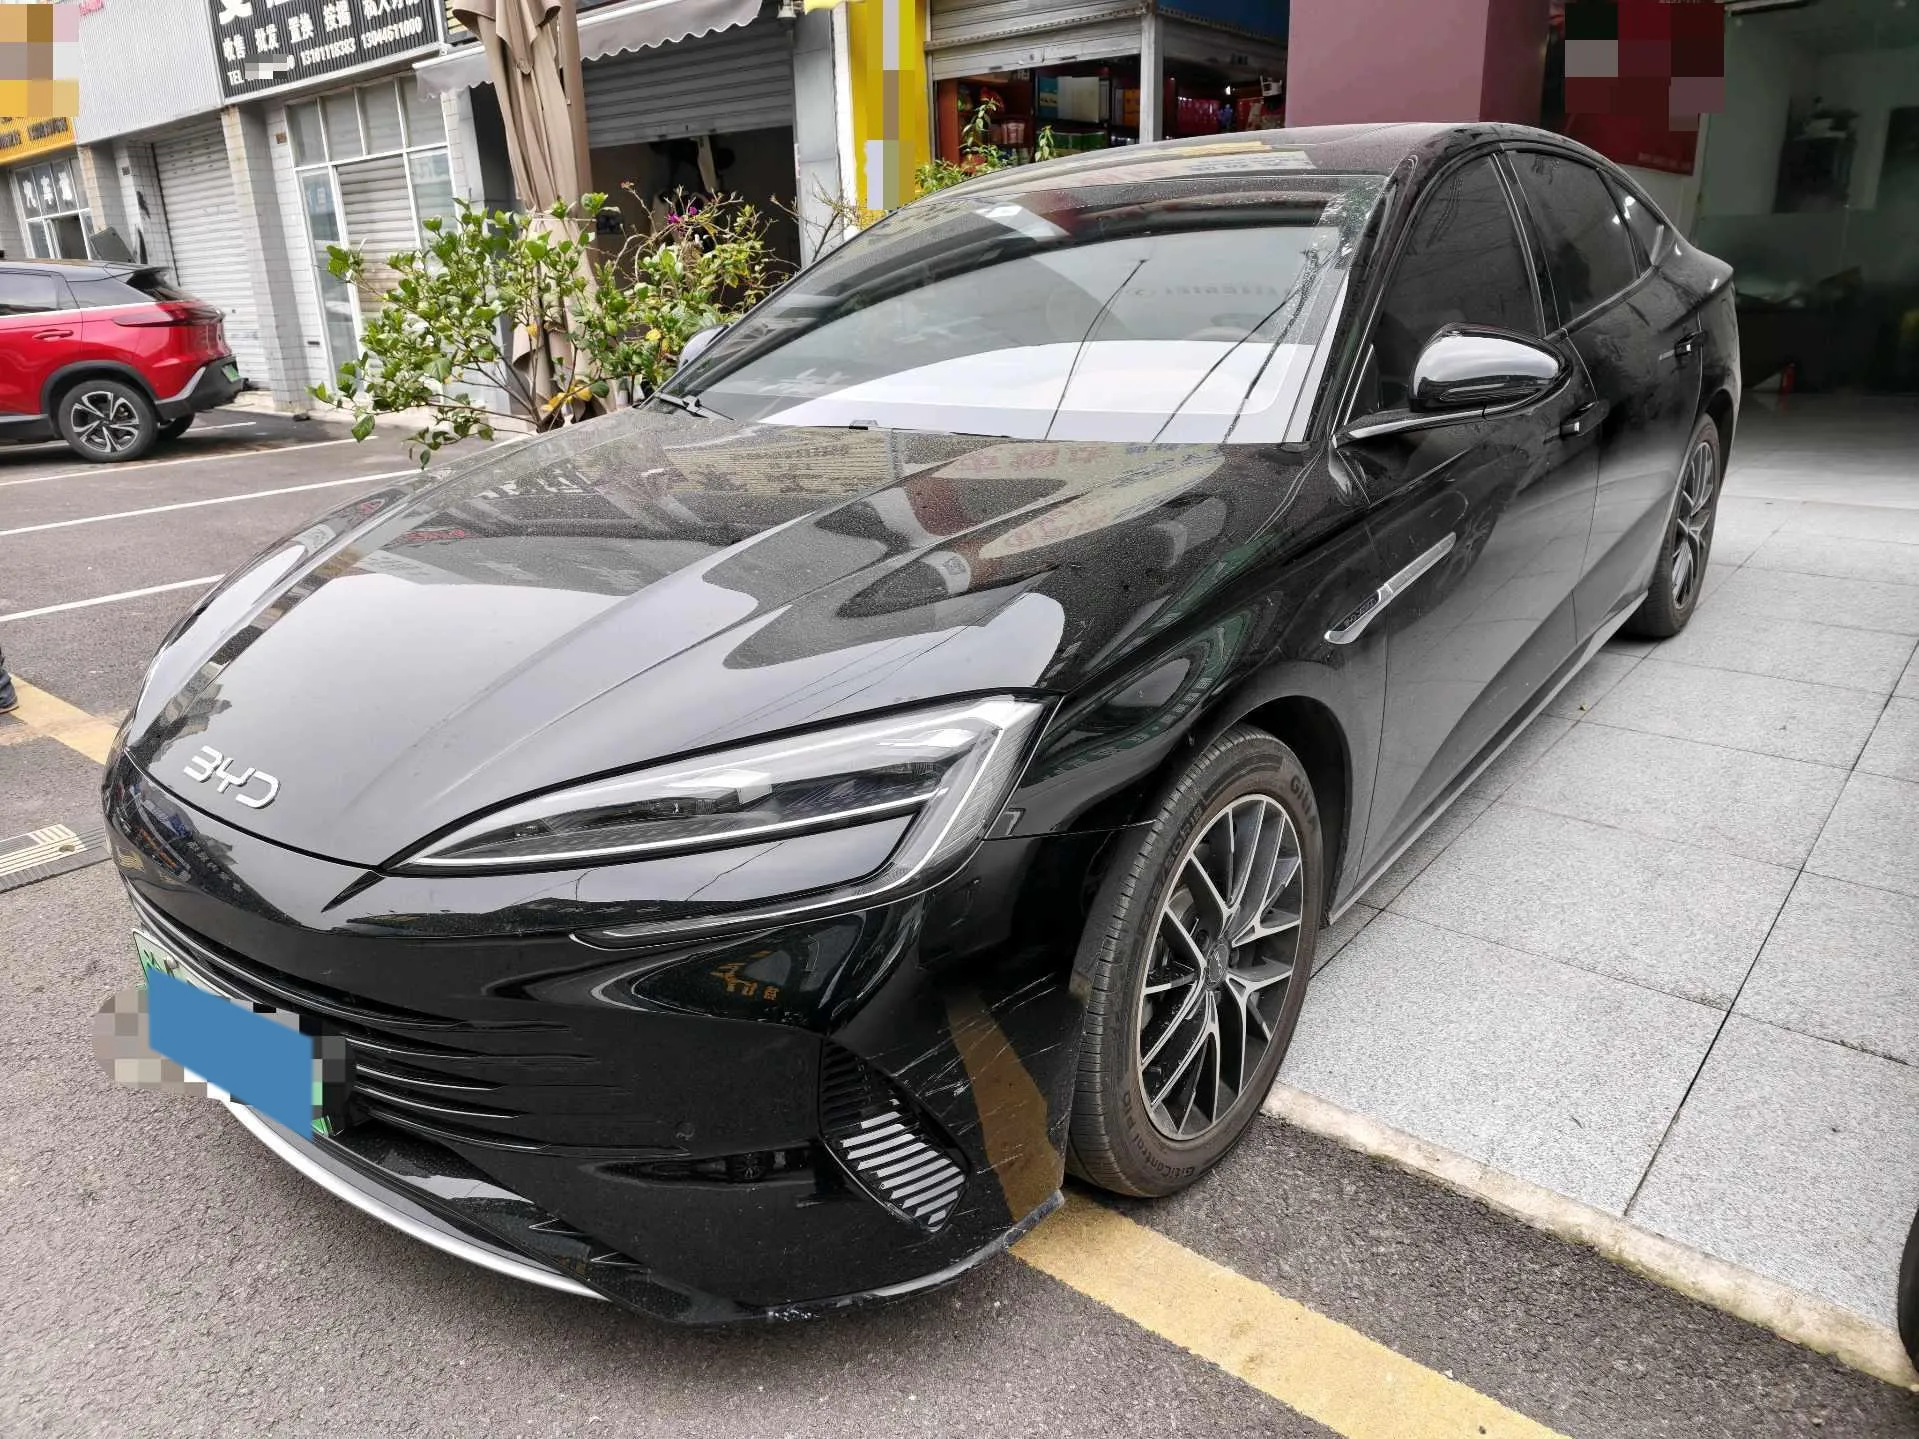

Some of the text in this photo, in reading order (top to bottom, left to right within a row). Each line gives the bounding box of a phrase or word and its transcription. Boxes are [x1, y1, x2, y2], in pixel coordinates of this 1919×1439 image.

[255, 24, 280, 54] 批发
[288, 15, 314, 44] 置换
[227, 70, 245, 86] TEL
[184, 745, 281, 809] BYD
